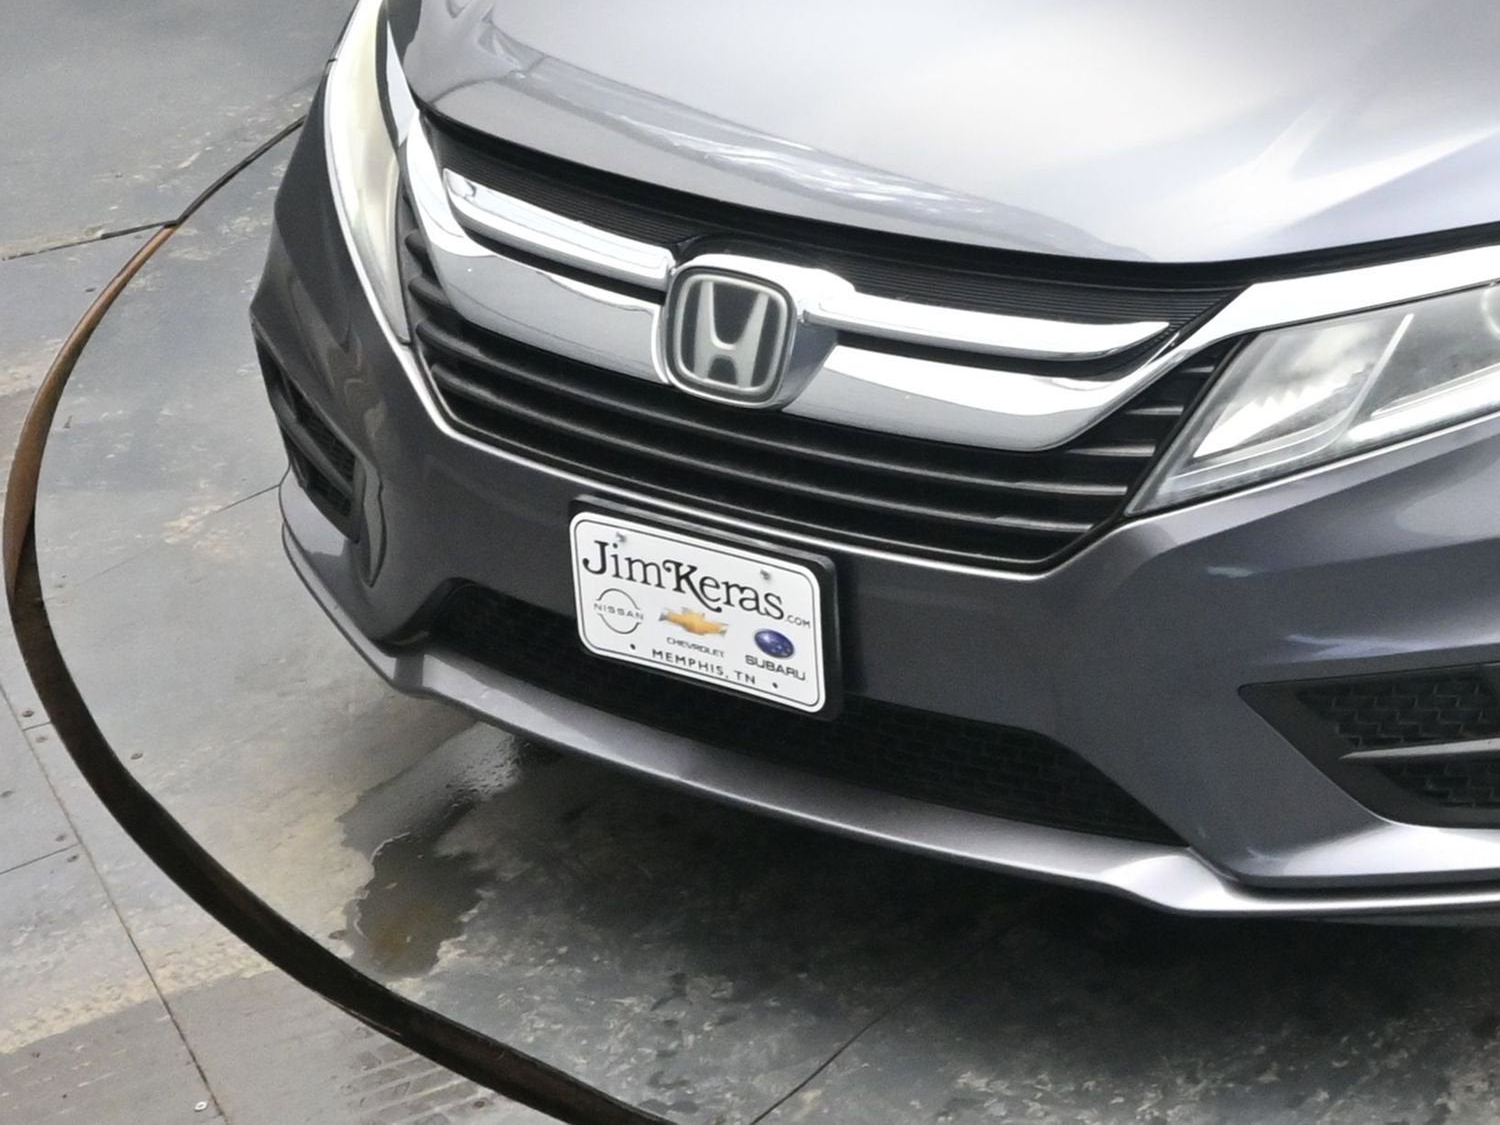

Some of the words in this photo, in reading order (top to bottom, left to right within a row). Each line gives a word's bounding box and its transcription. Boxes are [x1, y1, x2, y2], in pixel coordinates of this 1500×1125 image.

[593, 603, 644, 620] NISSAN
[666, 636, 725, 658] CHEVROLET
[651, 648, 729, 679] MEMPHIS,
[733, 670, 756, 685] TN
[744, 655, 806, 681] SUBARU
